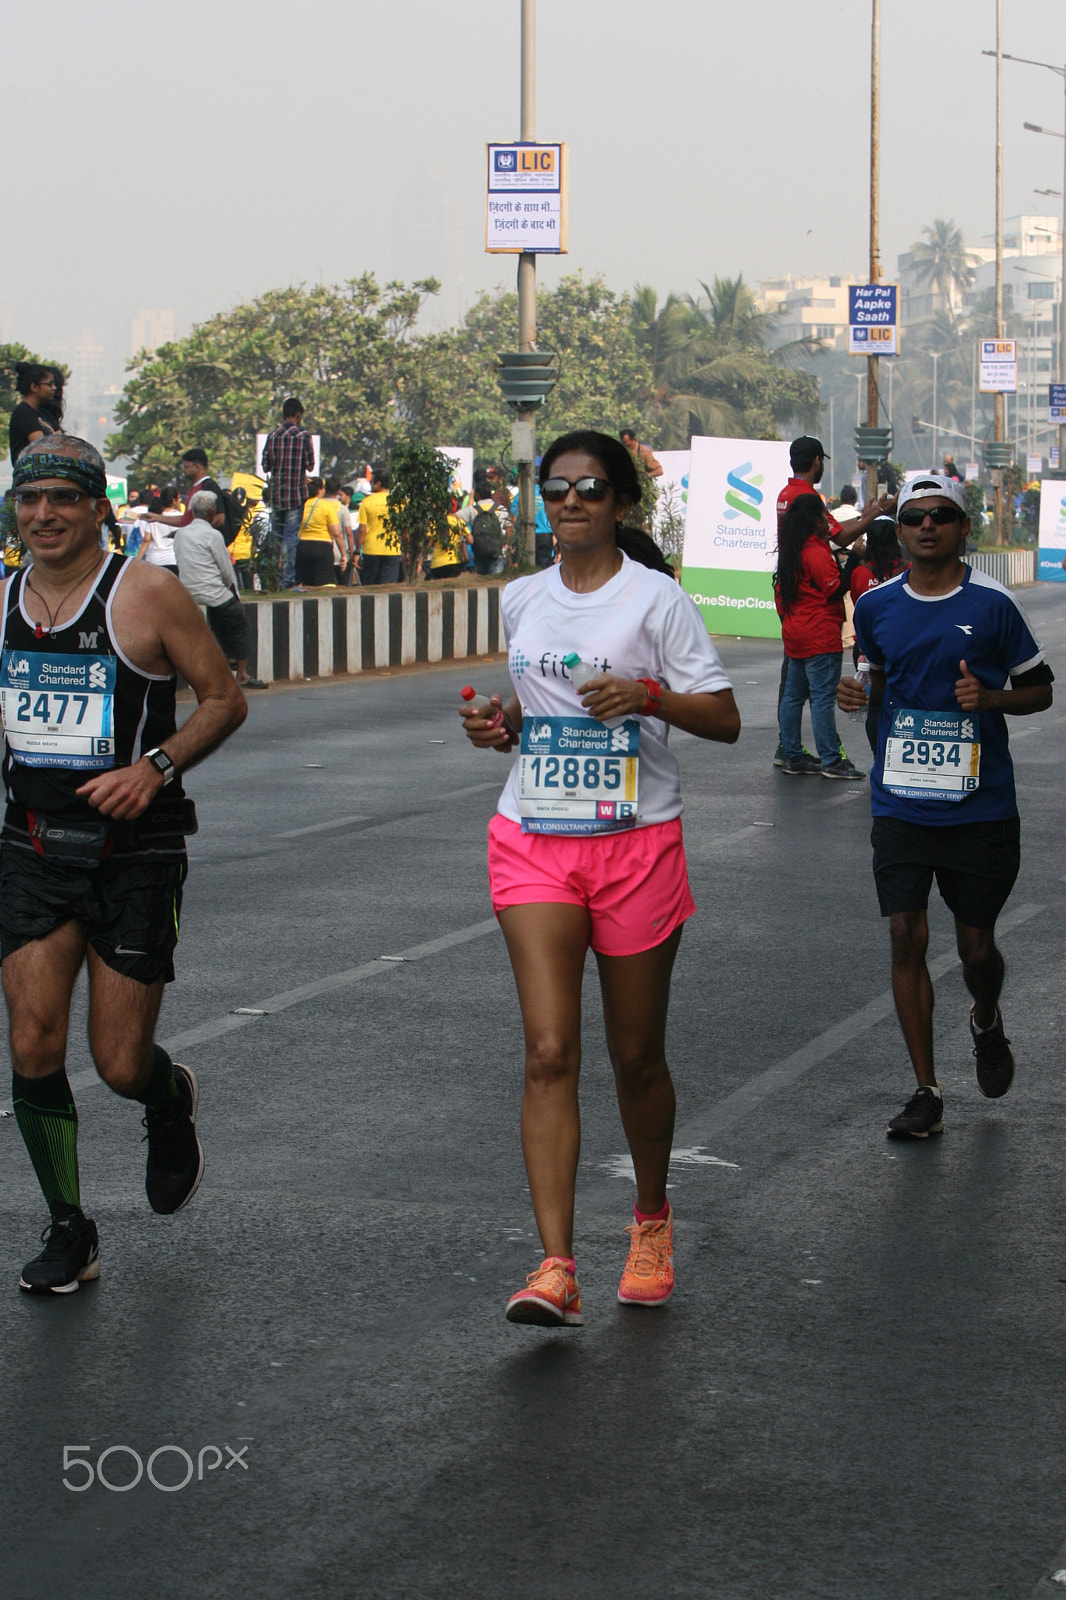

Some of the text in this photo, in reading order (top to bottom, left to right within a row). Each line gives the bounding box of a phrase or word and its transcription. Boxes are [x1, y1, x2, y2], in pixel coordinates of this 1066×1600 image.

[522, 152, 551, 170] LIC
[855, 288, 891, 297] Har Pal
[854, 298, 892, 311] Aapke
[856, 311, 890, 322] Saath
[870, 328, 890, 340] LIC
[996, 343, 1012, 353] LIC
[716, 524, 766, 537] Standard
[713, 536, 767, 550] Chartered
[689, 593, 777, 610] OneStepClos
[78, 631, 99, 649] M
[42, 663, 86, 675] Standard
[38, 674, 86, 686] Chartered
[17, 691, 89, 725] 2477
[924, 718, 959, 728] Standard
[562, 726, 608, 738] Standard
[920, 727, 959, 737] Chartered
[97, 740, 110, 754] B
[558, 737, 608, 749] Chartered
[902, 740, 961, 768] 2934
[25, 756, 71, 766] CONSULTANCY
[72, 759, 104, 767] SERVICES
[530, 757, 621, 790] 12885
[966, 777, 977, 790] B
[890, 788, 907, 796] TATA
[907, 790, 945, 799] CONSULTANCY
[600, 805, 612, 815] W
[620, 804, 633, 818] B
[542, 822, 592, 832] CONSULTANCY
